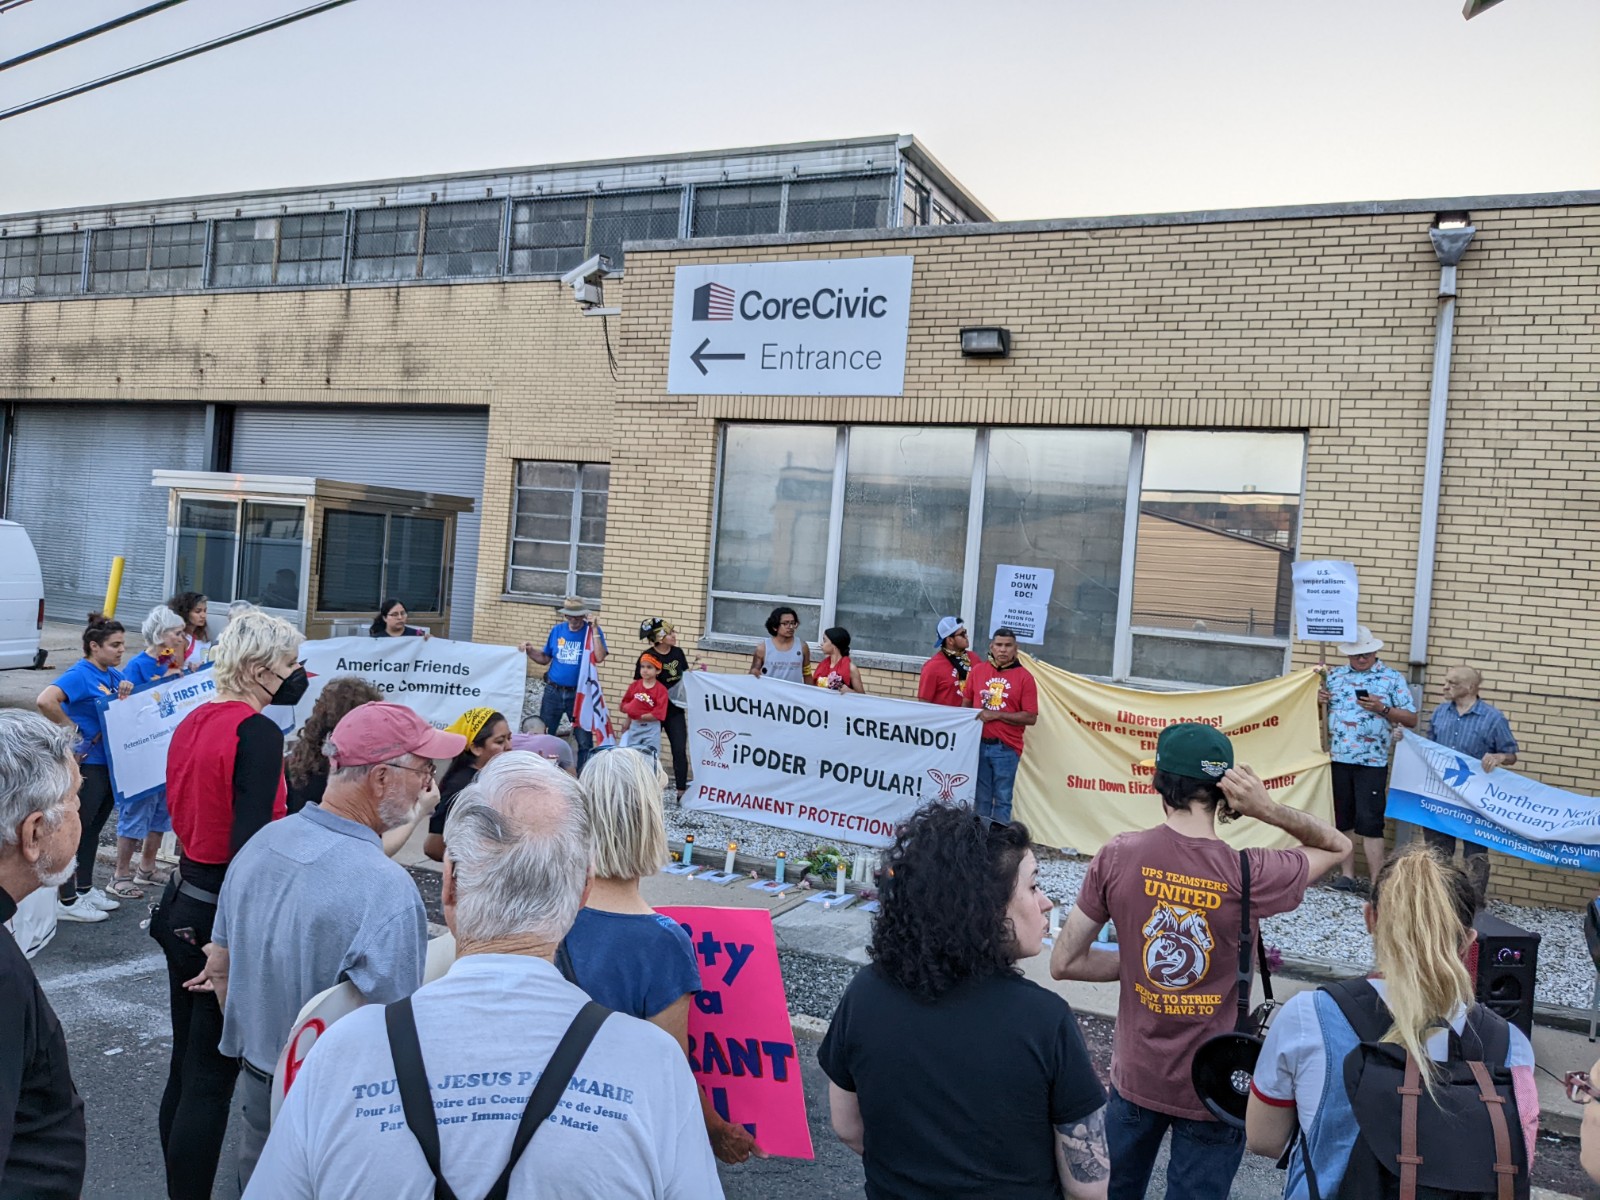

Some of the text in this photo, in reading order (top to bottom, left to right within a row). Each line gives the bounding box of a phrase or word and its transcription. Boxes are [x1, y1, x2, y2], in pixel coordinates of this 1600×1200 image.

[740, 287, 887, 321] CoreCivic
[761, 343, 882, 370] Entrance
[1011, 581, 1038, 590] DOWN
[1014, 572, 1037, 581] SHUT
[1014, 590, 1033, 599] EDC!
[336, 658, 471, 677] American Friends
[173, 684, 199, 702] FIRST
[398, 680, 482, 698] Committee
[704, 693, 957, 751] ¡LUCHANDO! ¡CREANDO!
[1116, 710, 1168, 727] Liberen
[1129, 729, 1160, 739] cent
[1262, 715, 1279, 728] de
[1140, 740, 1157, 751] Eli
[701, 759, 730, 770] COSECHA
[732, 743, 923, 797] ¡PODER POPULAR!
[1067, 775, 1096, 790] Shut
[1099, 778, 1127, 793] Down
[1262, 774, 1297, 791] enter
[698, 785, 894, 837] PERMANENT PROTECTION
[1484, 783, 1560, 817] Northern
[1477, 797, 1562, 832] Sanctuary
[1420, 799, 1474, 825] Supporting
[1560, 843, 1600, 858] Asylum
[1474, 828, 1581, 868] www.nnjsanctuary.org
[1141, 866, 1228, 893] UPS TEAMSTERS
[1144, 878, 1222, 911] UNITED
[1162, 994, 1178, 1004] TO
[1180, 994, 1222, 1005] STRIKE
[1165, 1004, 1195, 1015] HAVE
[1197, 1004, 1214, 1015] TO
[688, 1031, 795, 1082] RANT
[352, 1078, 399, 1100] TOU
[437, 1071, 513, 1090] JESUS
[568, 1076, 635, 1105] MARIE
[355, 1106, 386, 1119] Pour
[467, 1095, 487, 1106] du
[575, 1102, 592, 1114] de
[593, 1105, 629, 1122] Jesus
[379, 1119, 404, 1133] Par
[435, 1115, 468, 1126] oeur
[559, 1114, 600, 1133] Marie
